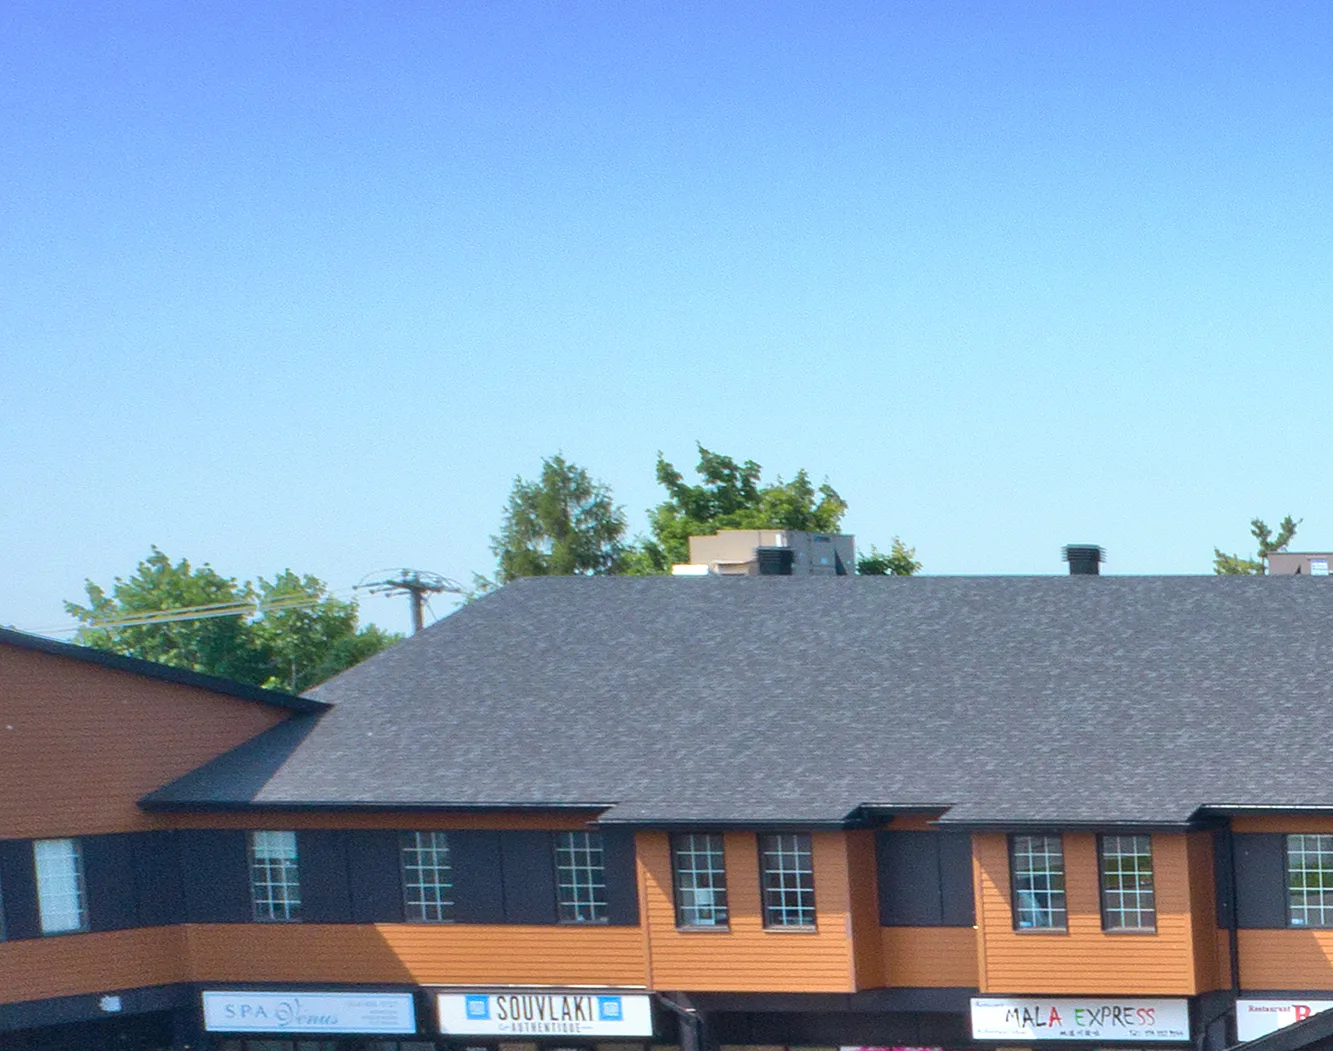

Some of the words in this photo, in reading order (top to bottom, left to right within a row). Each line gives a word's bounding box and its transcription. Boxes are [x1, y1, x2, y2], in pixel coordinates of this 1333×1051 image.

[224, 1004, 268, 1019] SPA
[496, 995, 594, 1021] SOUVLAKI
[1005, 1006, 1062, 1028] MALA
[1074, 1006, 1155, 1028] EXPRESS
[511, 1023, 582, 1033] AUTHENTIQUE
